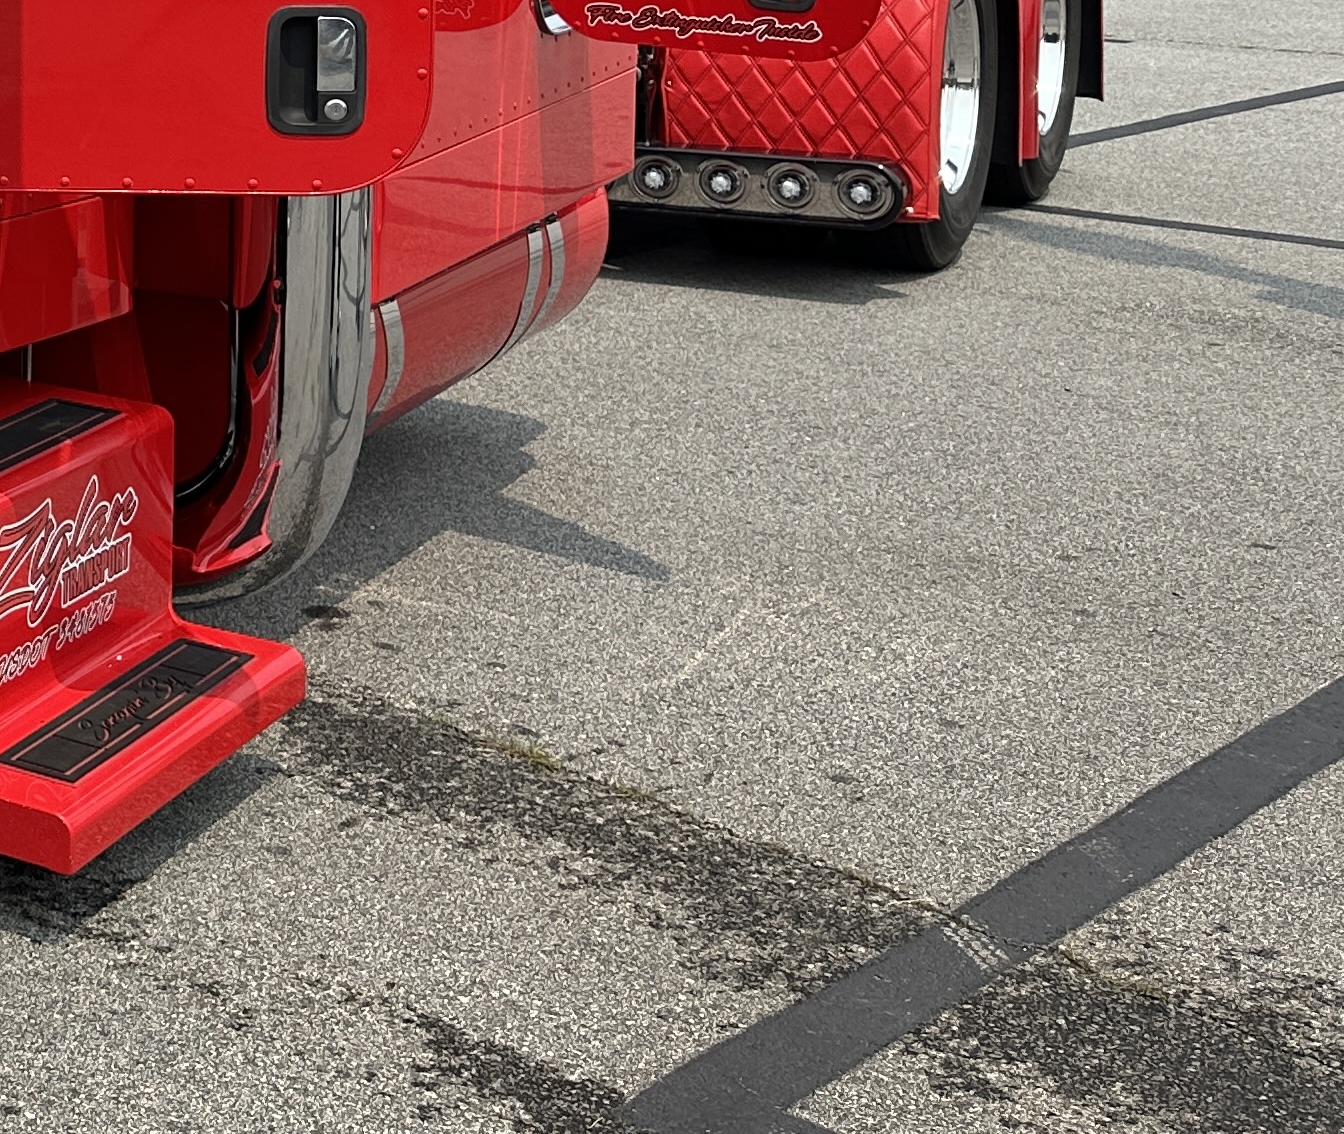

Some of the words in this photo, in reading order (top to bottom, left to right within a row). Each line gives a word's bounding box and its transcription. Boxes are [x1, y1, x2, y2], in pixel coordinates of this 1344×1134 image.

[586, 3, 632, 26] Fire
[630, 4, 754, 37] Extinguisher
[753, 16, 822, 42] Inside
[62, 535, 131, 607] TRANSPORT
